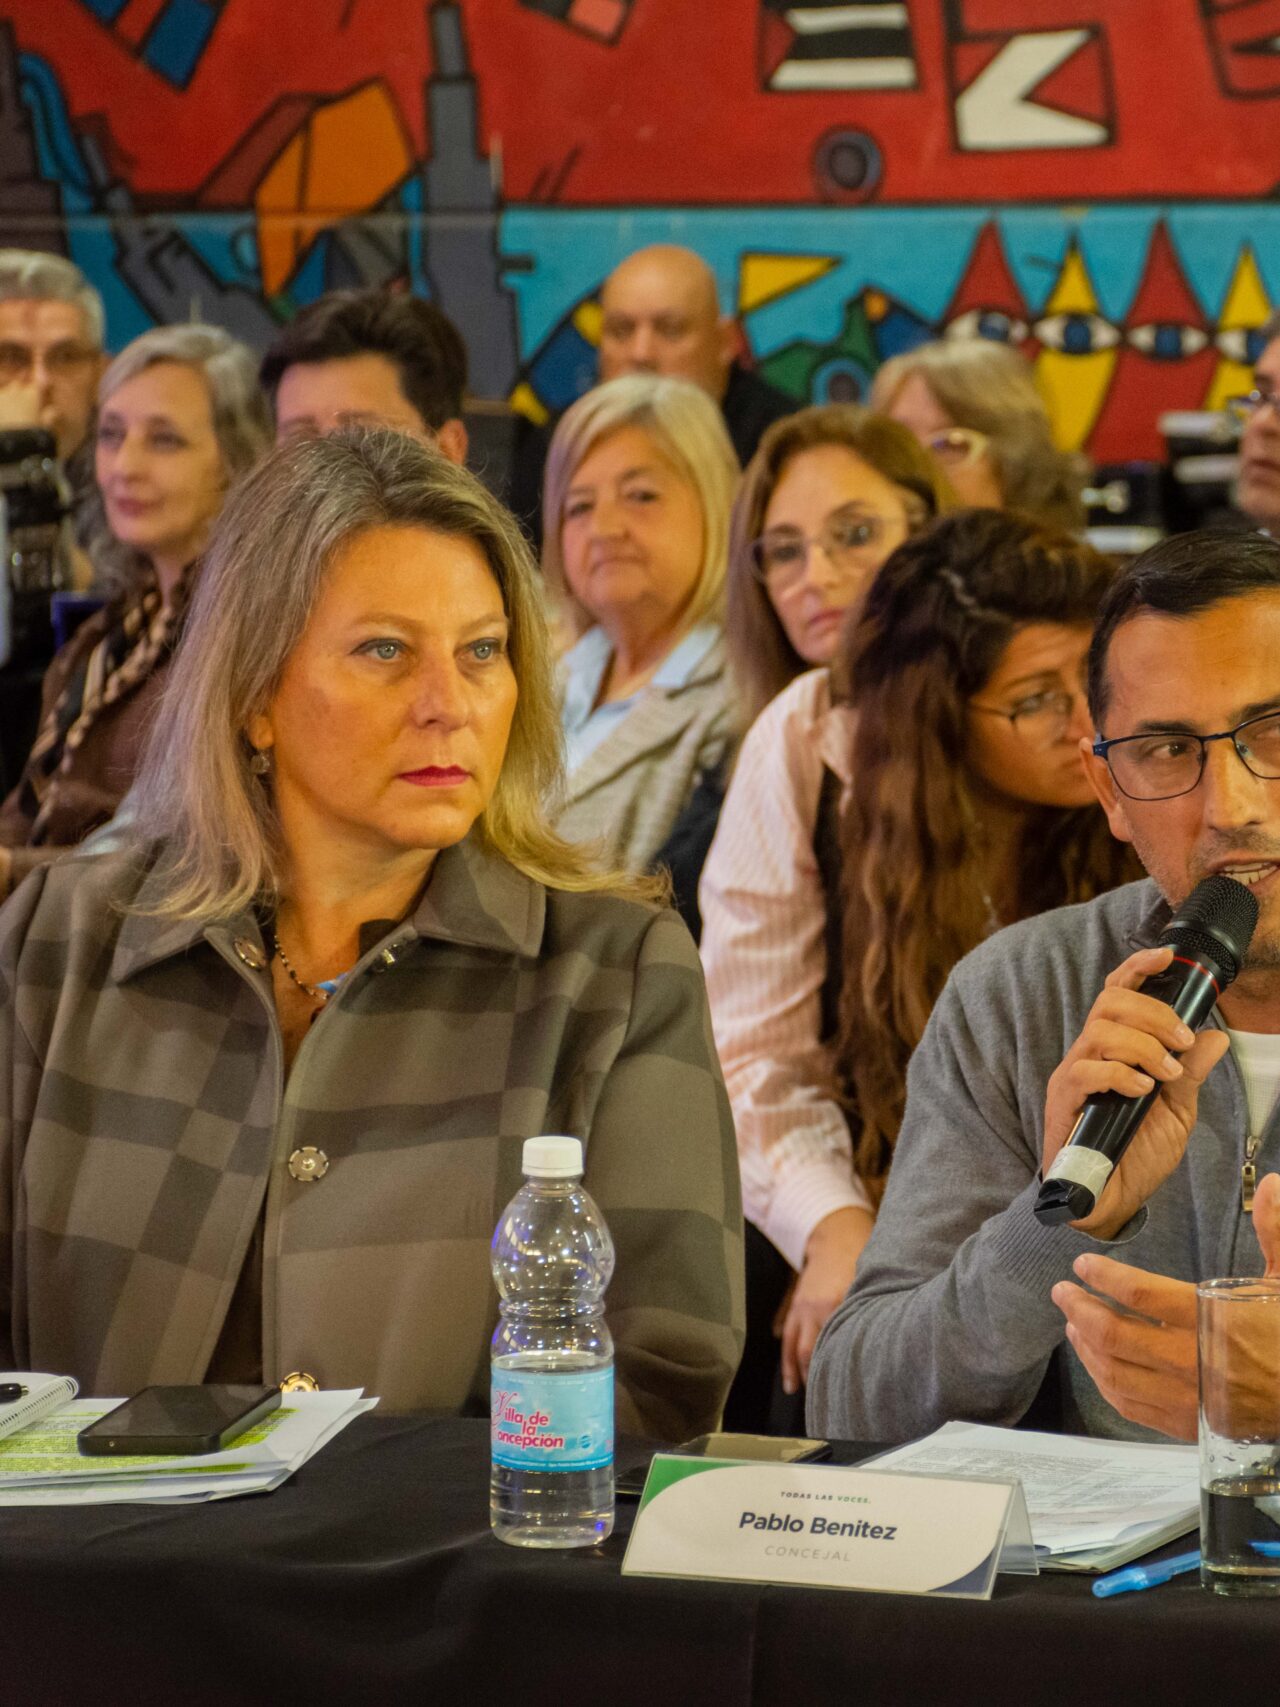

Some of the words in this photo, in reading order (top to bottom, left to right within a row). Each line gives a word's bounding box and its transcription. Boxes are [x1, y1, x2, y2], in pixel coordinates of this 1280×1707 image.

[529, 1411, 548, 1426] de
[522, 1420, 536, 1436] la
[497, 1431, 564, 1450] oncepción
[780, 1491, 812, 1500] TODAS
[739, 1511, 804, 1533] Pablo
[809, 1517, 897, 1540] Benitez
[764, 1545, 851, 1562] CONCEJAL
